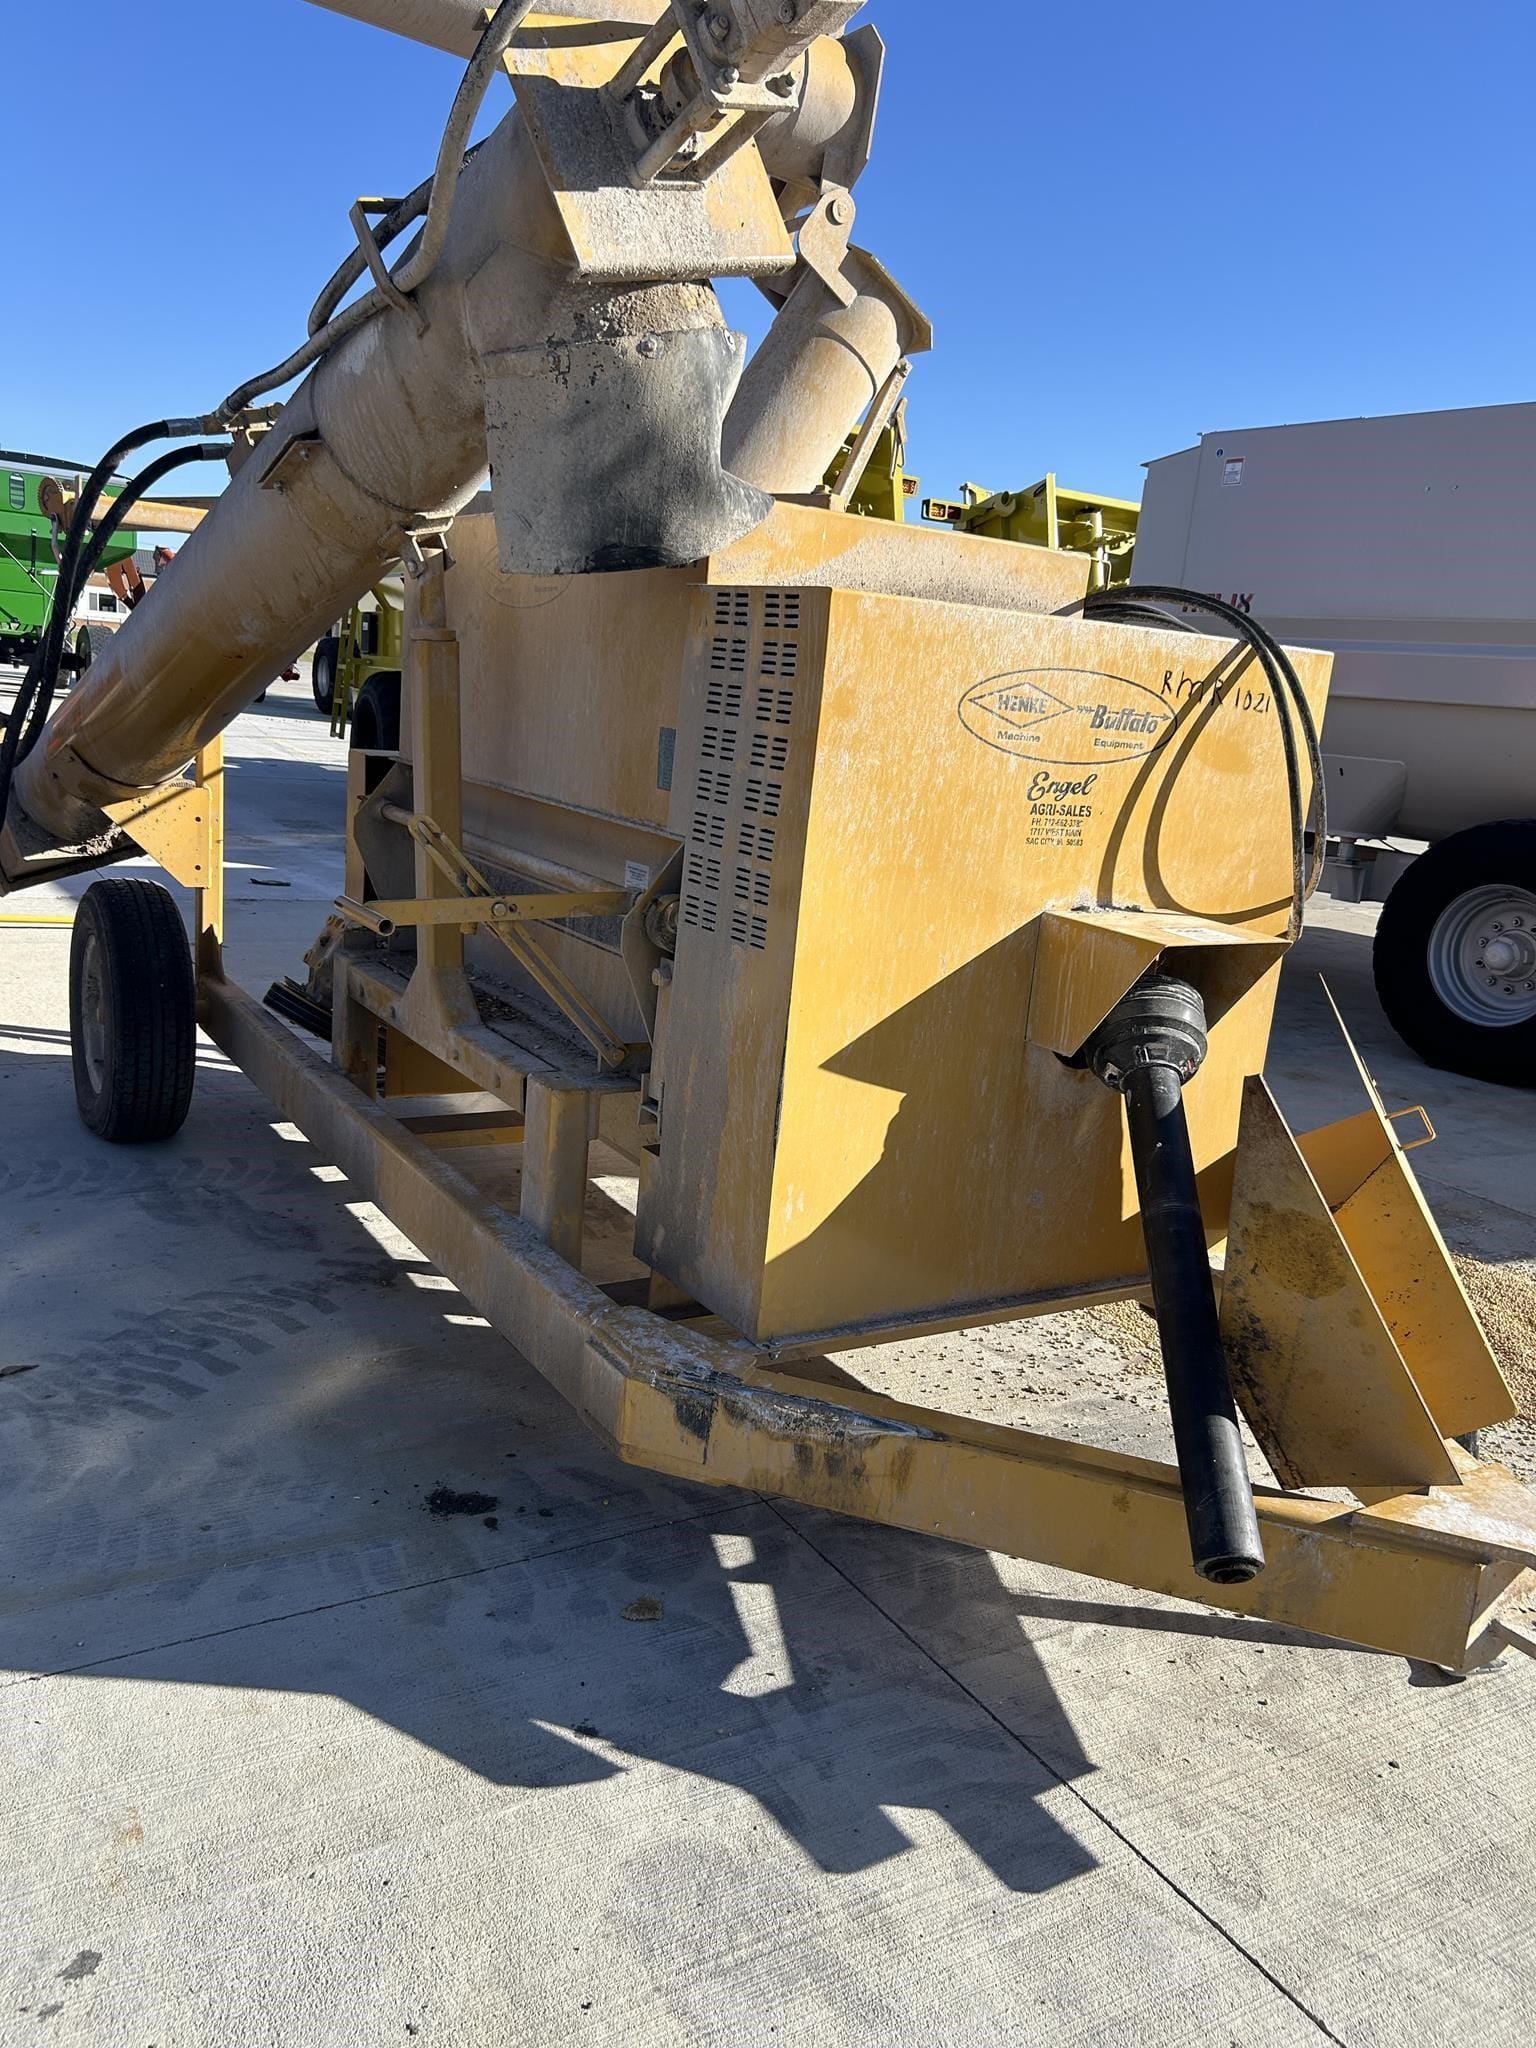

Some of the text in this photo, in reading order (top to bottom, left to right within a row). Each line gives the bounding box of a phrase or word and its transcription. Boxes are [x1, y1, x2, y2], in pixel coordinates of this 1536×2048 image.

[998, 694, 1047, 714] HENKE
[1235, 687, 1271, 713] 1021
[1090, 704, 1158, 733] Buffalo
[997, 730, 1041, 742] Machine
[1094, 737, 1144, 749] Equipment
[1027, 771, 1098, 801] Engel
[1030, 803, 1092, 818] AGRI-SALES
